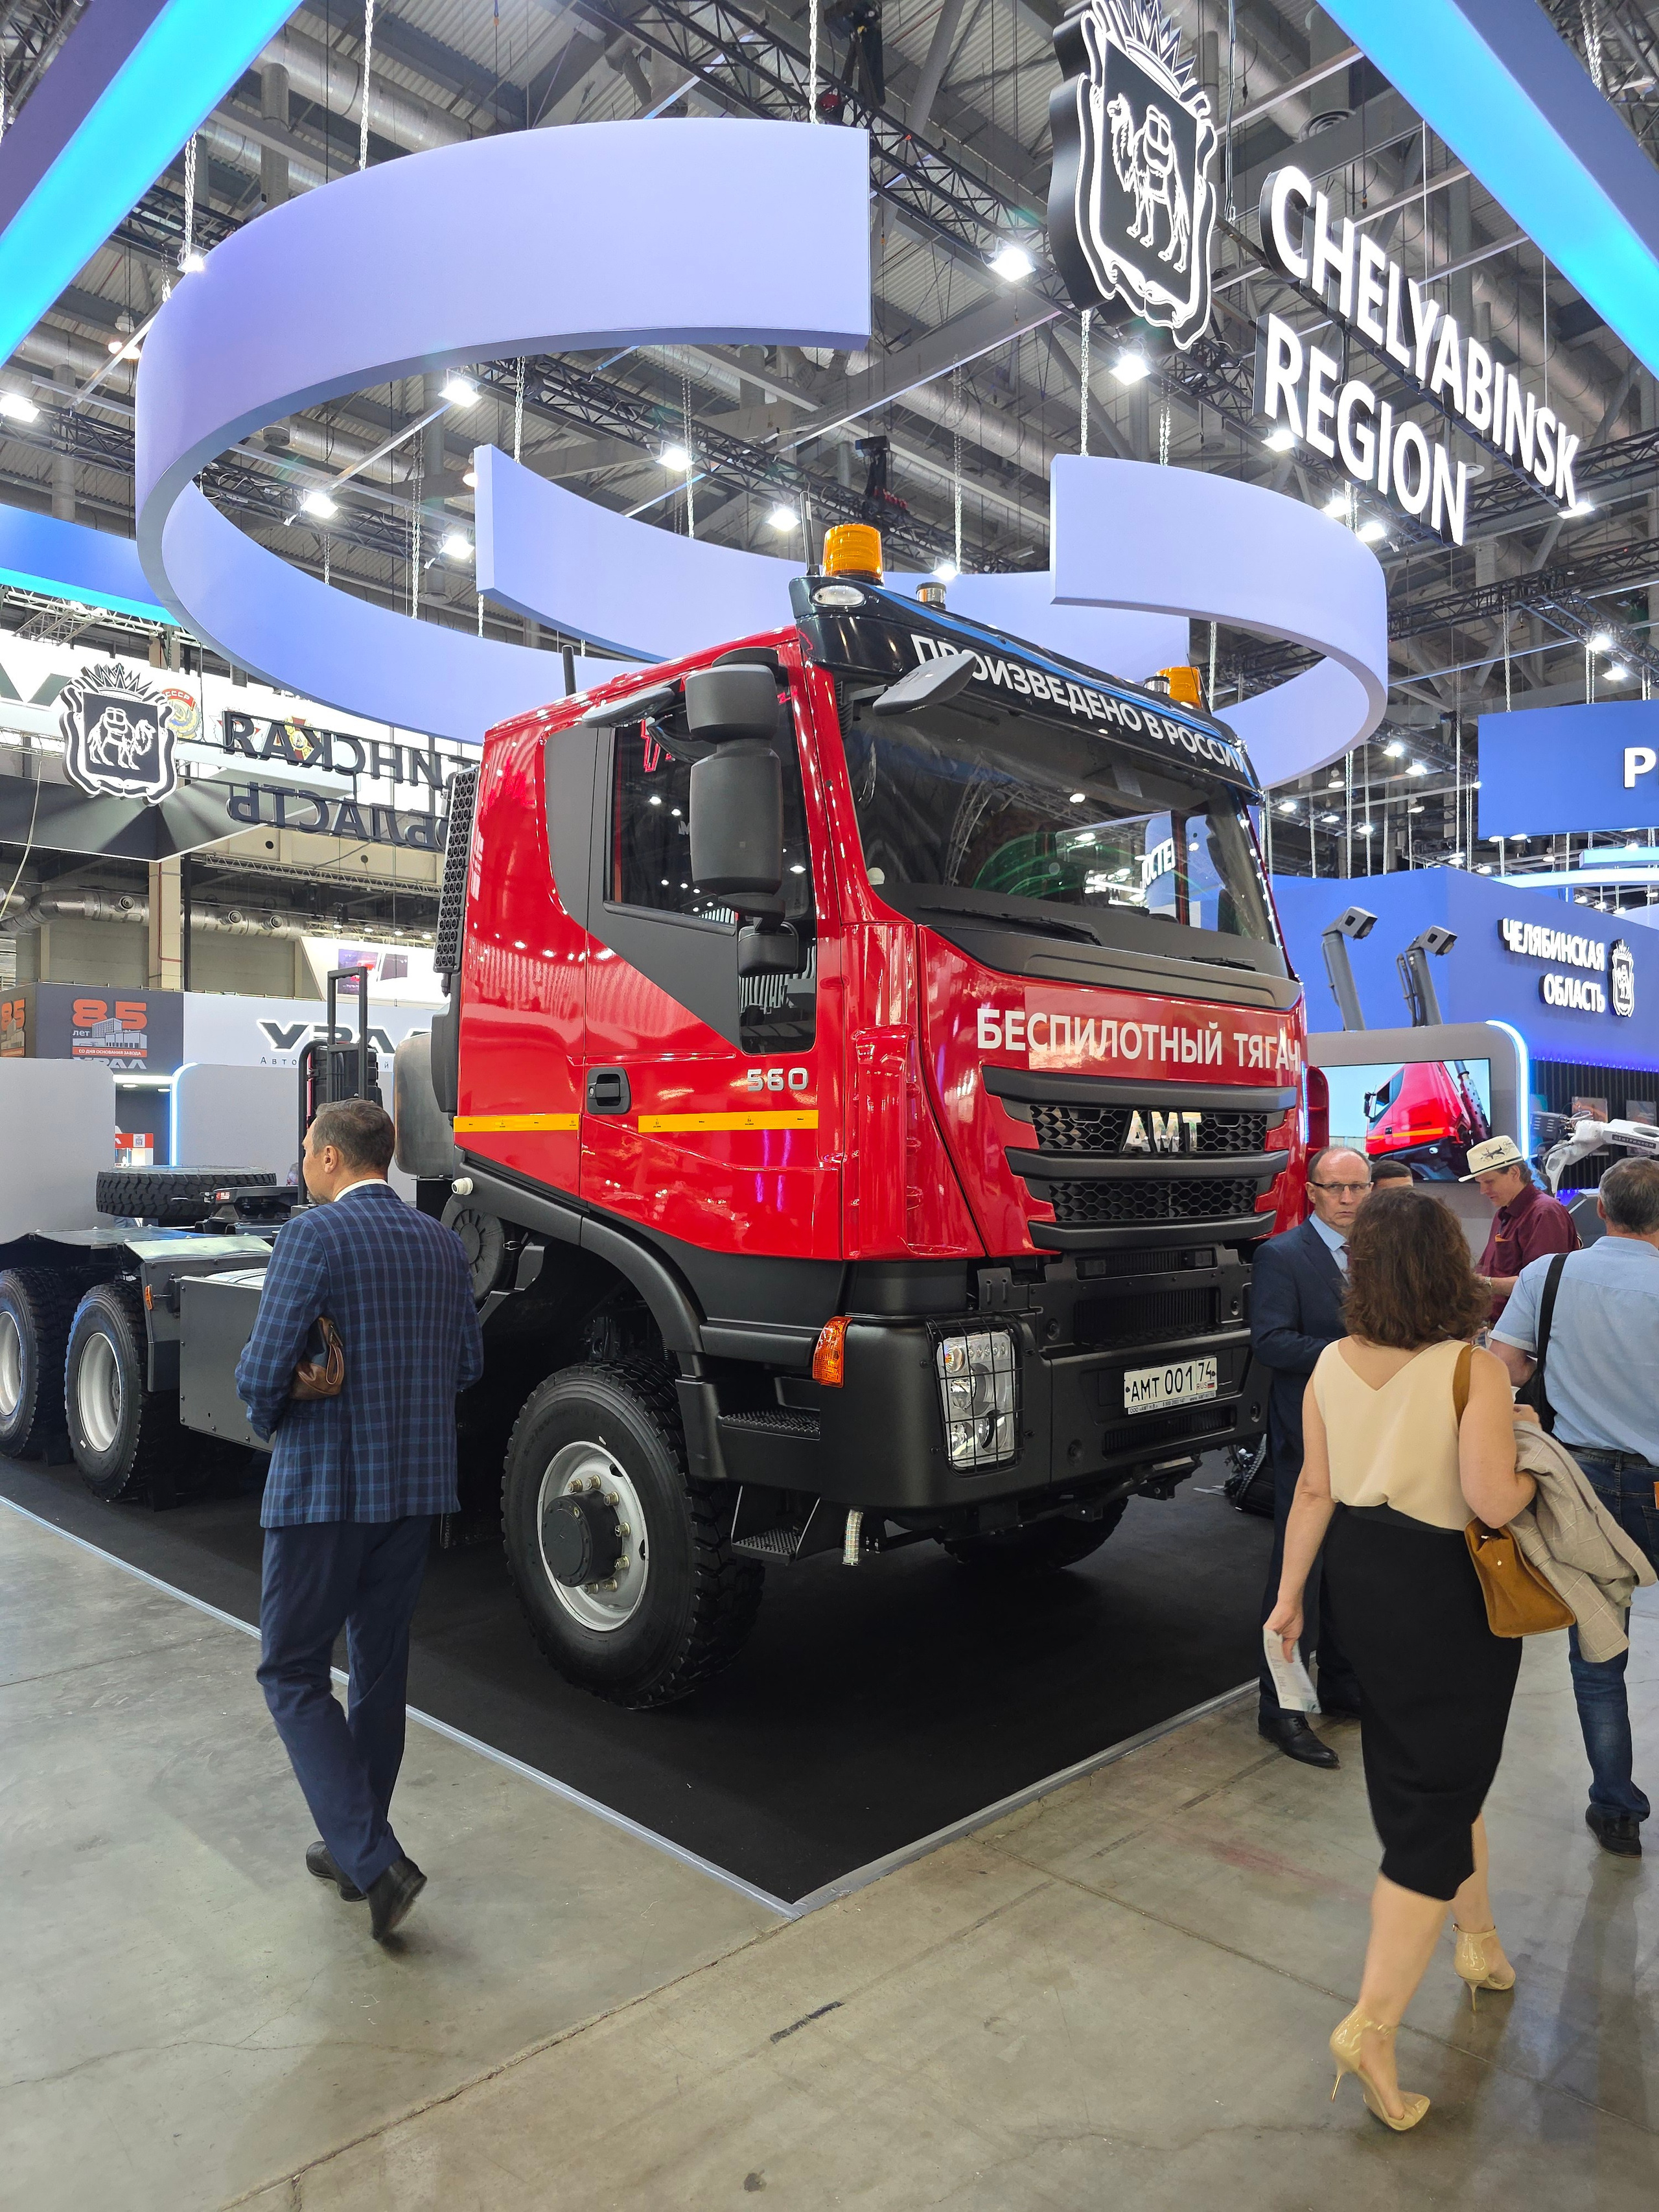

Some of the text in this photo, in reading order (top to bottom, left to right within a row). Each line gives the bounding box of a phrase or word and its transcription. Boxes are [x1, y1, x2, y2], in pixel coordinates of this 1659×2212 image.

[1269, 165, 1580, 509] CHELYABINSK
[1264, 313, 1467, 546] REGION
[165, 690, 190, 700] СССР
[911, 634, 1252, 777] ПОИЗВЕДЕНО В РОССИИ
[1502, 918, 1605, 972] ЧЕЛЯБИНСКАЯ
[1543, 973, 1606, 1013] ОБЛАСТЬ
[1, 999, 25, 1032] 85
[72, 999, 148, 1029] 85
[977, 1008, 1301, 1071] БЕСПИЛОТНЫЙ ТЯГАЧ
[747, 1067, 809, 1092] 560
[1131, 1361, 1212, 1403] АМТ 001 74
[1196, 1382, 1207, 1390] RUS
